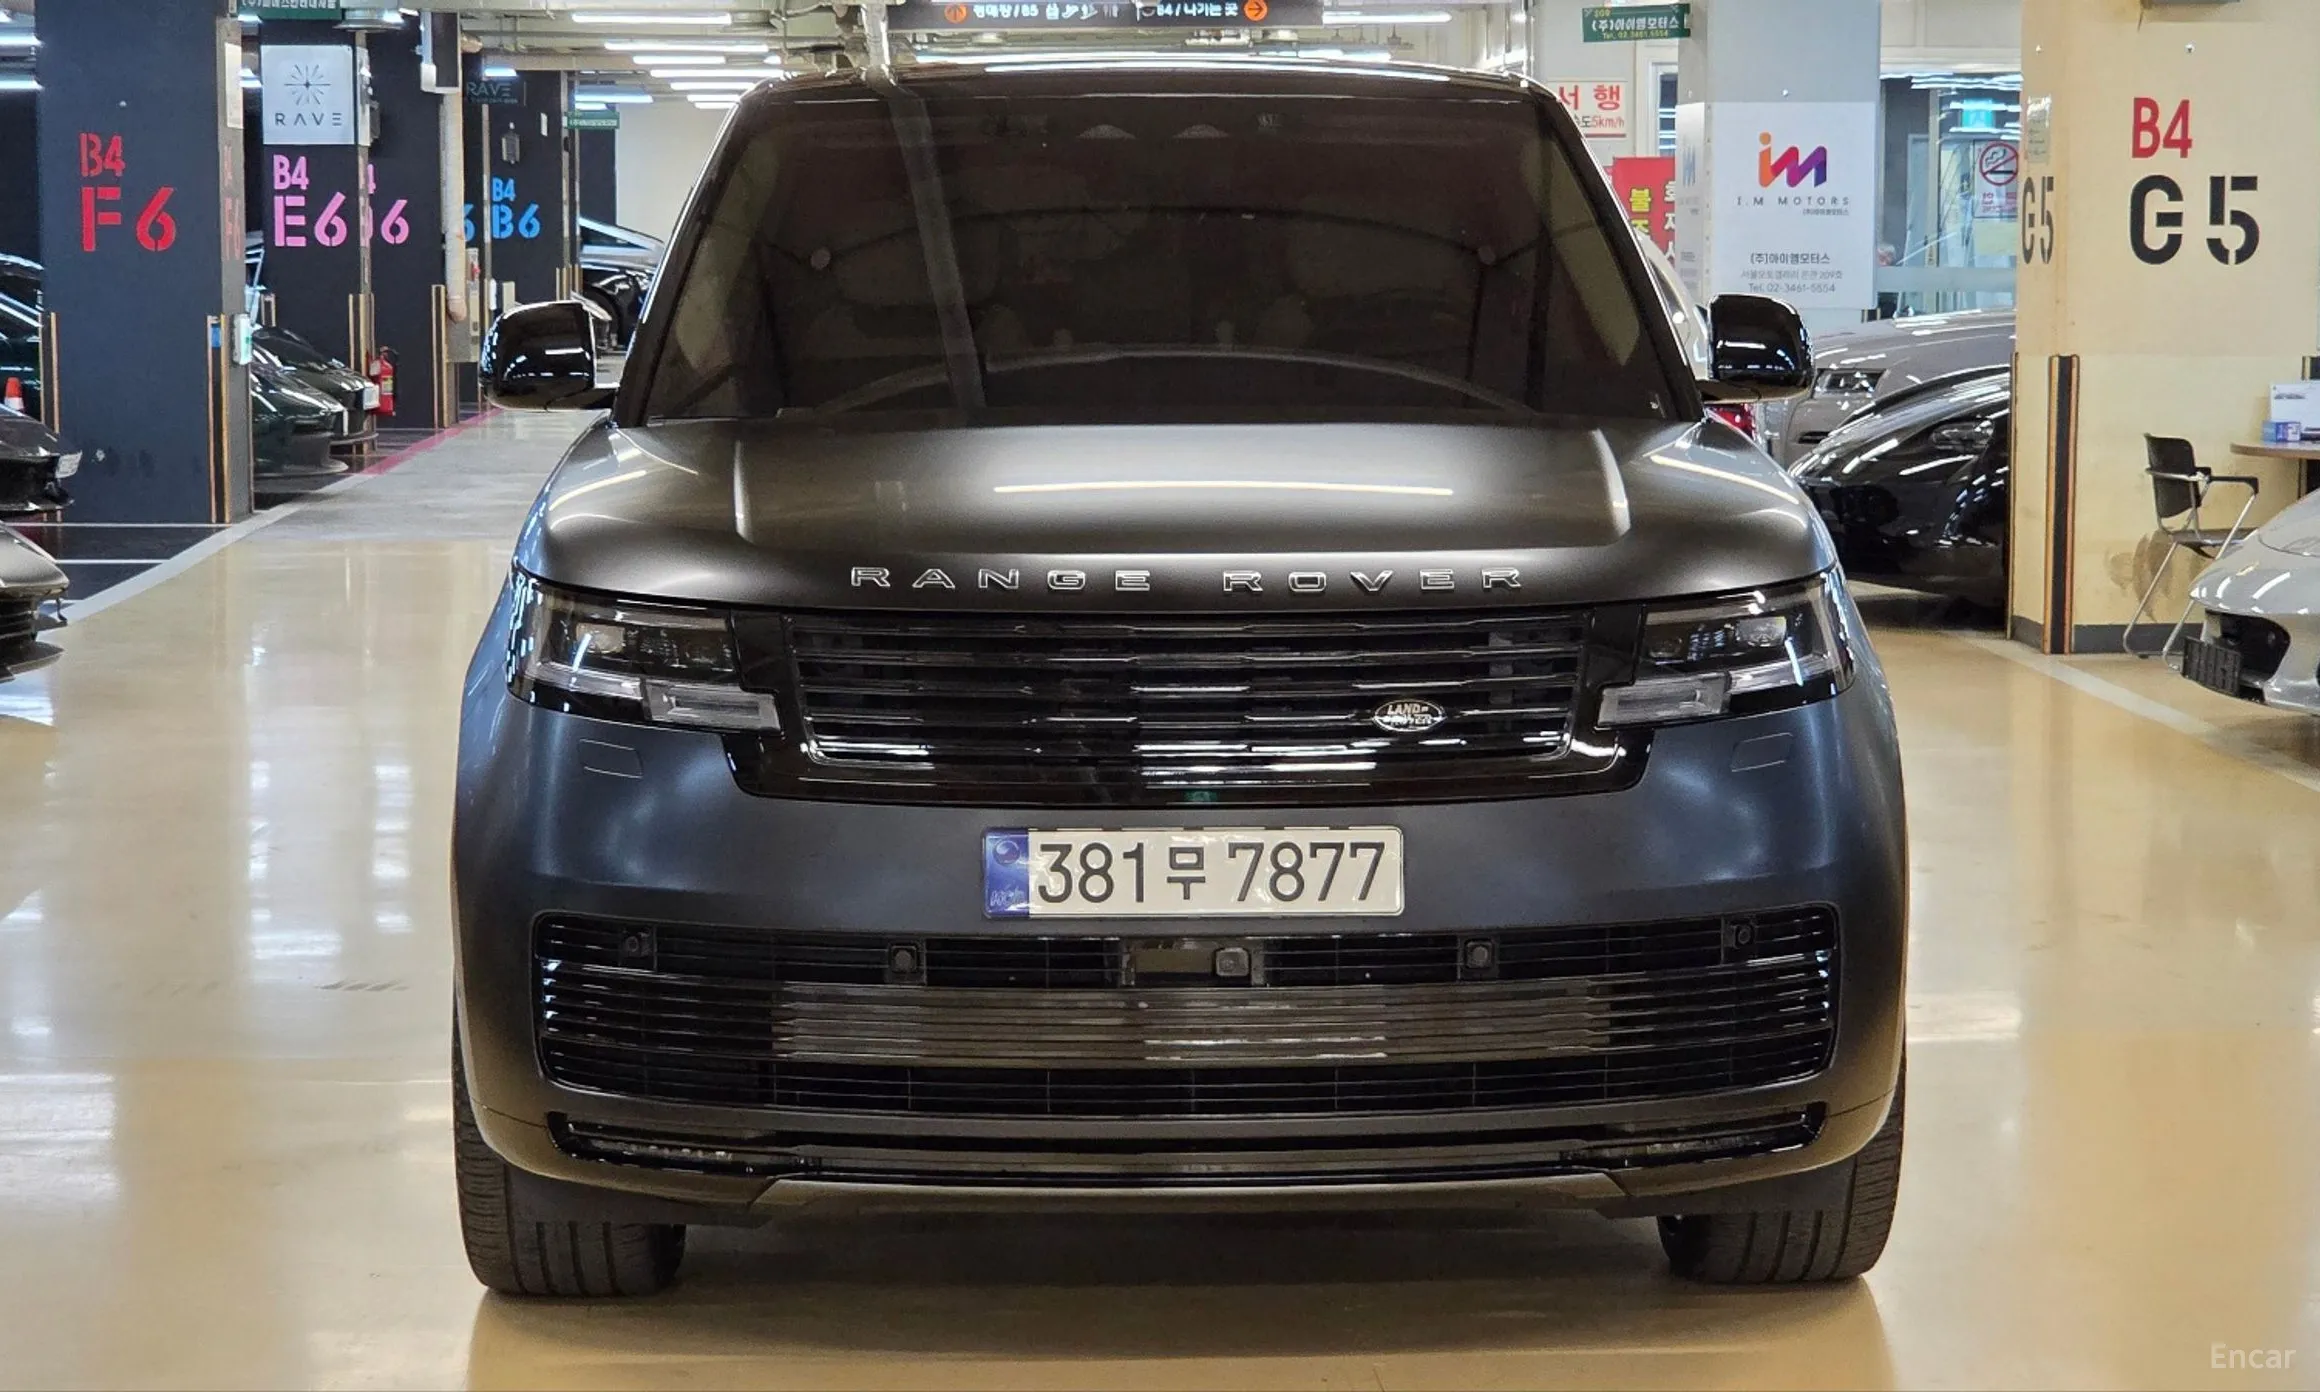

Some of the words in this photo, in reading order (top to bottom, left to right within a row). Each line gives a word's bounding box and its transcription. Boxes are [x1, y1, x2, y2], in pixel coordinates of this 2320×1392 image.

[274, 112, 342, 127] RAVE
[2131, 97, 2193, 159] B4
[80, 132, 126, 178] B4
[273, 155, 309, 190] B4
[492, 176, 516, 202] B4
[1777, 196, 1849, 206] MOTORS
[850, 566, 1153, 592] RANGE
[1221, 566, 1524, 592] ROVER
